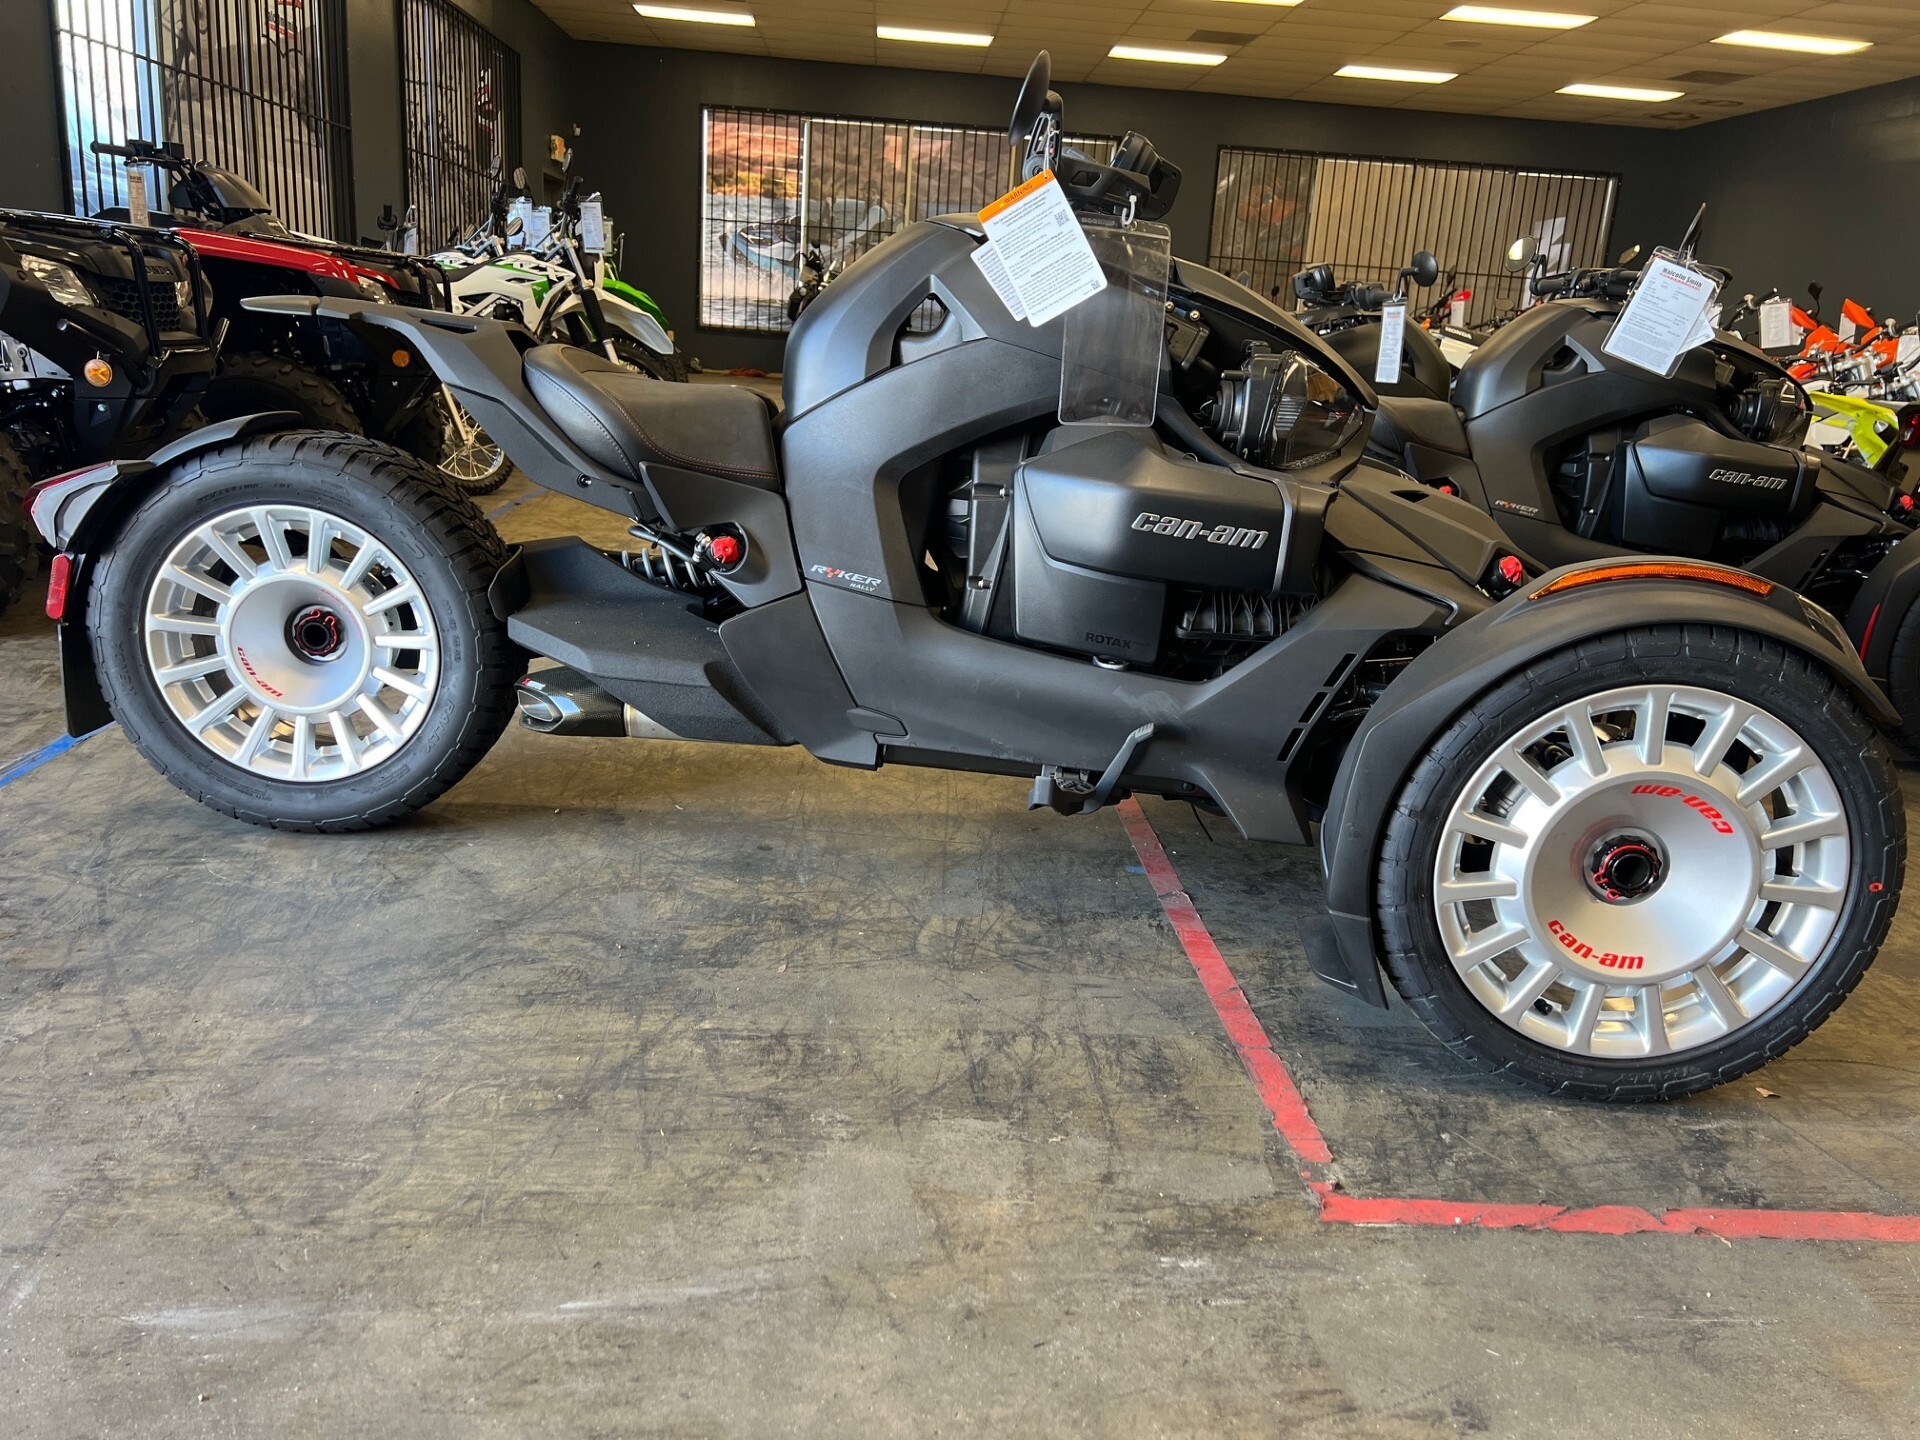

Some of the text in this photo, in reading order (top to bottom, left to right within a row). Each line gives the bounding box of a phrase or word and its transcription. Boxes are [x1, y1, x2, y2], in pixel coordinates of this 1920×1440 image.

[1003, 183, 1033, 204] WARNING
[1661, 267, 1687, 281] Malcolm
[1686, 275, 1703, 288] Smith
[1708, 468, 1788, 490] can-am
[1131, 512, 1269, 549] can-am
[810, 564, 883, 587] RYKER
[849, 583, 876, 592] RALLY
[1085, 631, 1131, 649] ROTAX
[237, 646, 284, 698] can-am
[1631, 783, 1734, 835] can-am
[1547, 919, 1644, 970] can-am
